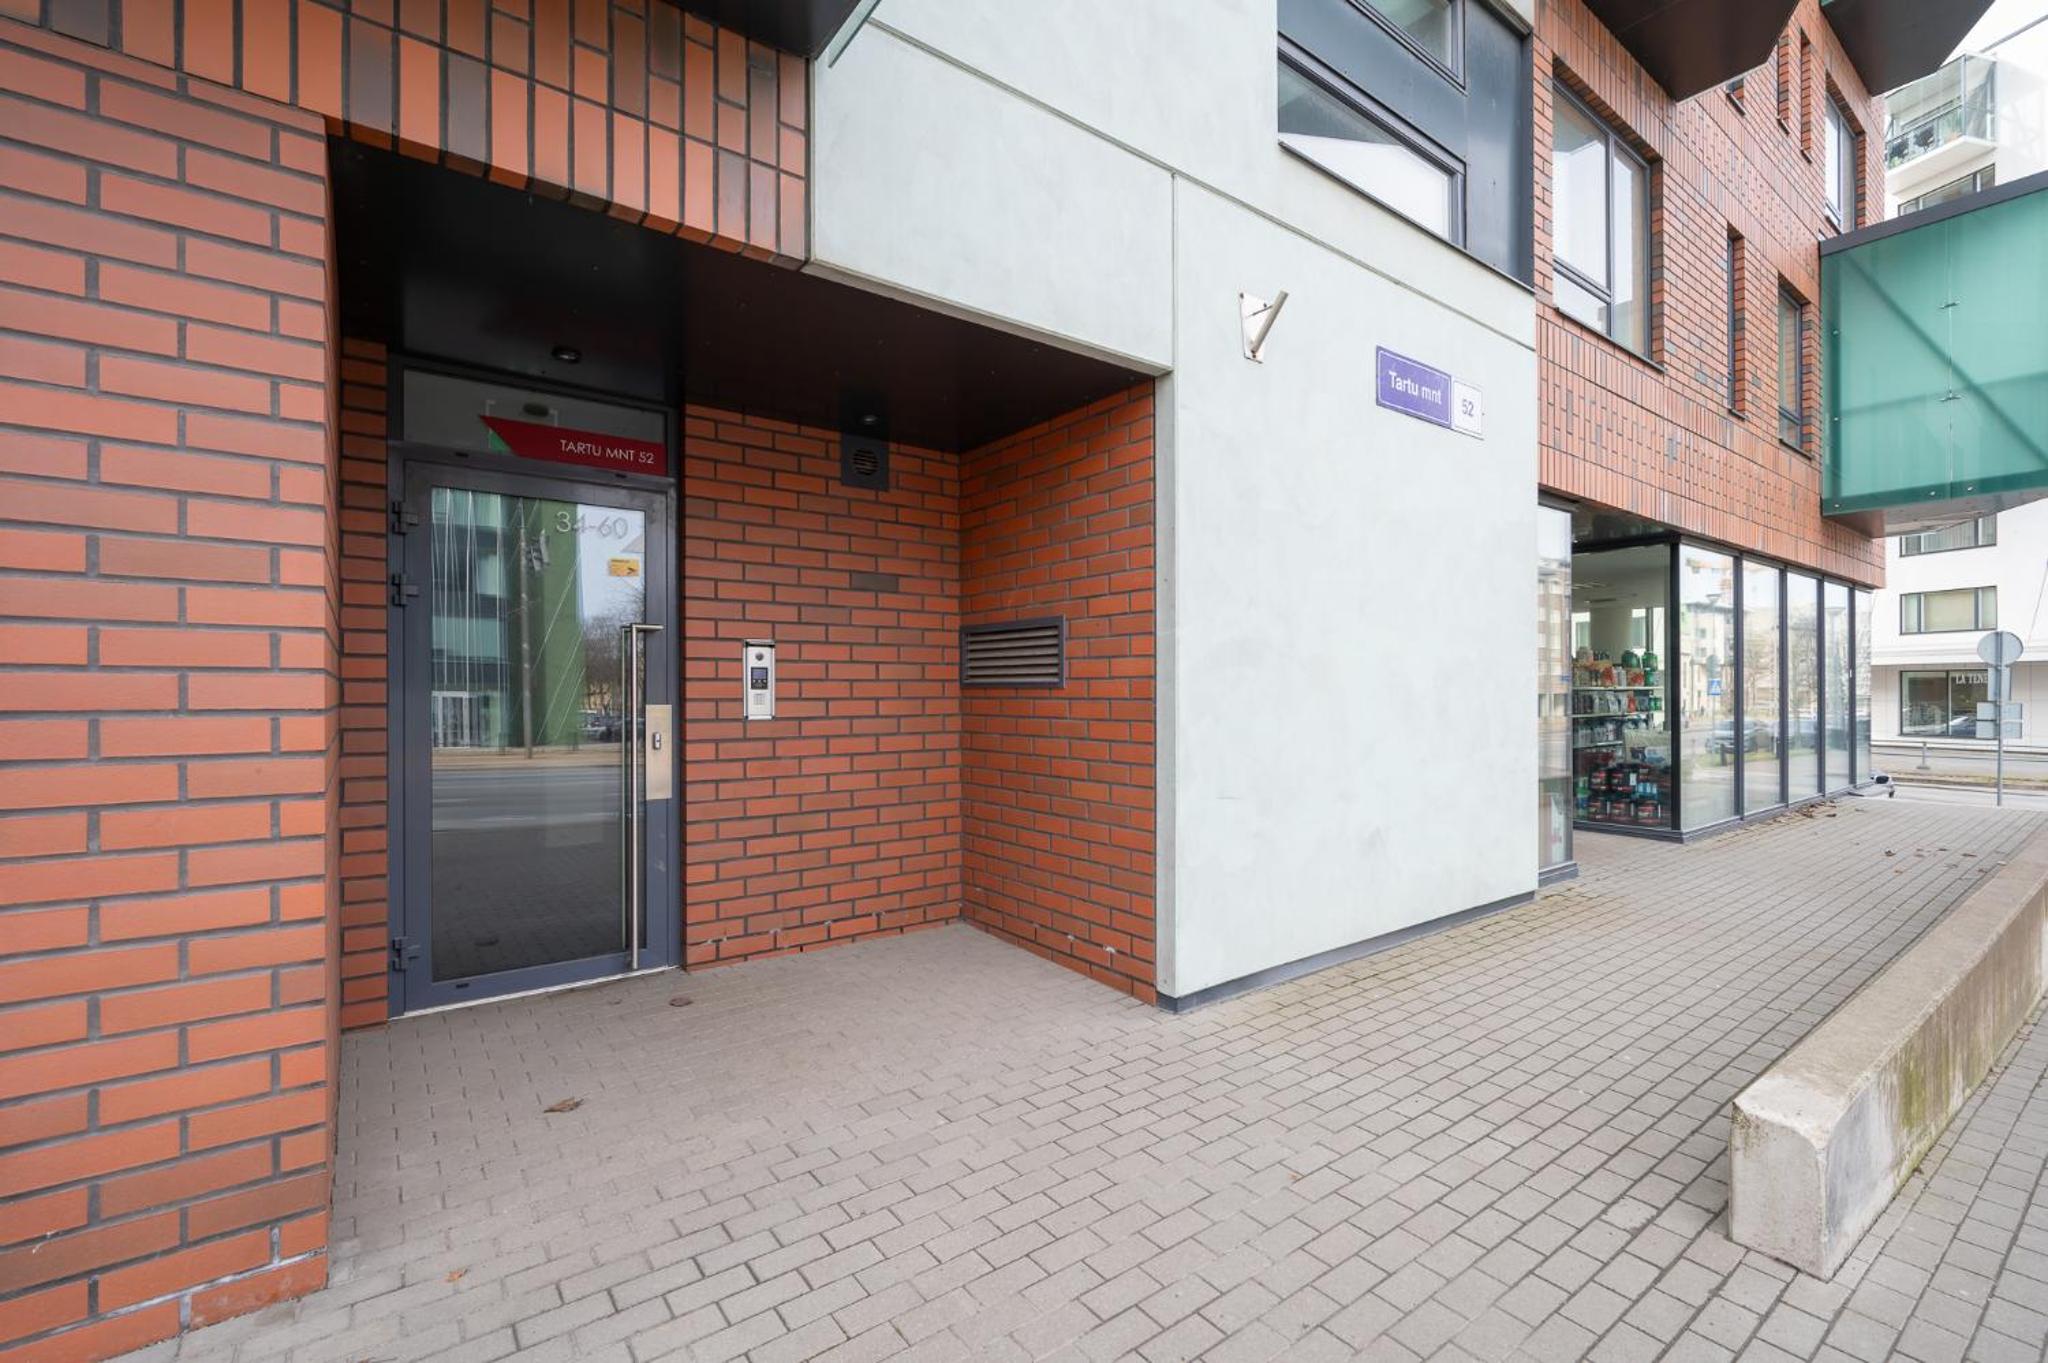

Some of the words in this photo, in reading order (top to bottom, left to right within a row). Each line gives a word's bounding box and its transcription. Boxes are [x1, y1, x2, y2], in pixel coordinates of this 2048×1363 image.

[1388, 370, 1419, 396] Tartu
[1421, 387, 1442, 405] mnt
[1462, 398, 1475, 417] 52
[560, 440, 602, 457] TARTU
[605, 447, 635, 461] MNT
[638, 451, 655, 464] 52
